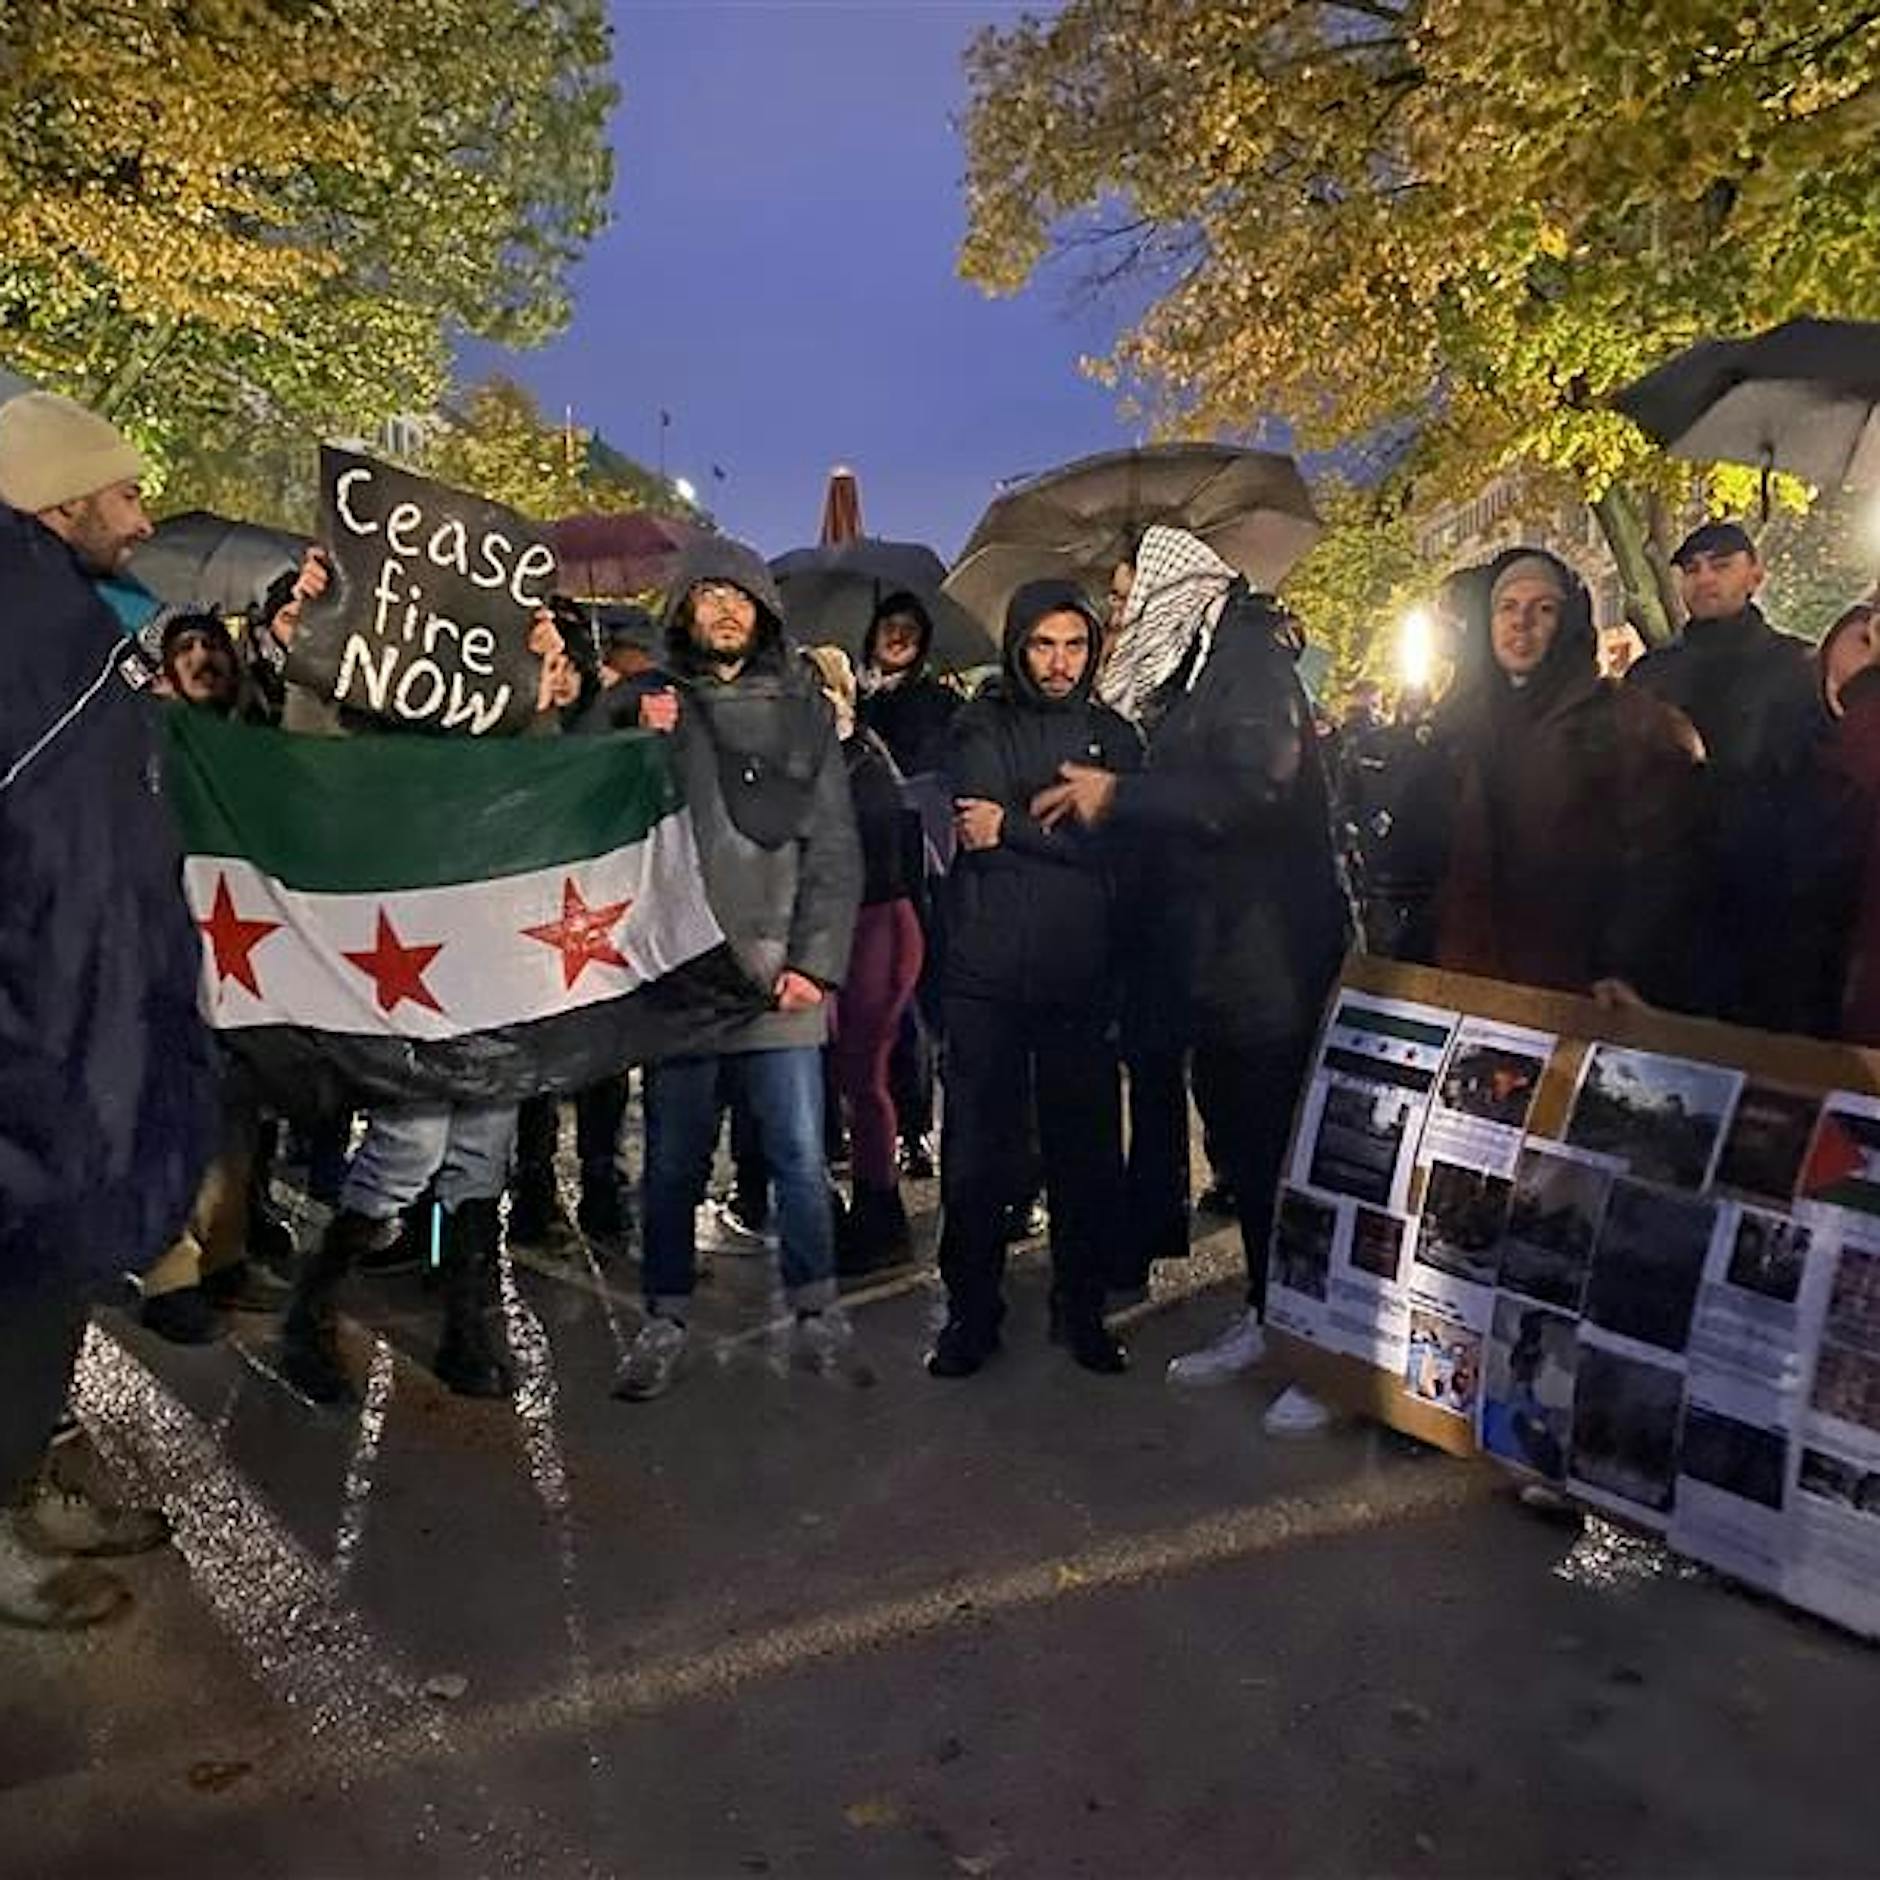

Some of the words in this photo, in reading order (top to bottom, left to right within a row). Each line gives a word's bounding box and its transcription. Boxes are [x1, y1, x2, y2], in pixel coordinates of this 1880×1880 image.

[336, 468, 556, 606] Cease
[374, 558, 494, 675] fire
[333, 633, 511, 735] NOW
